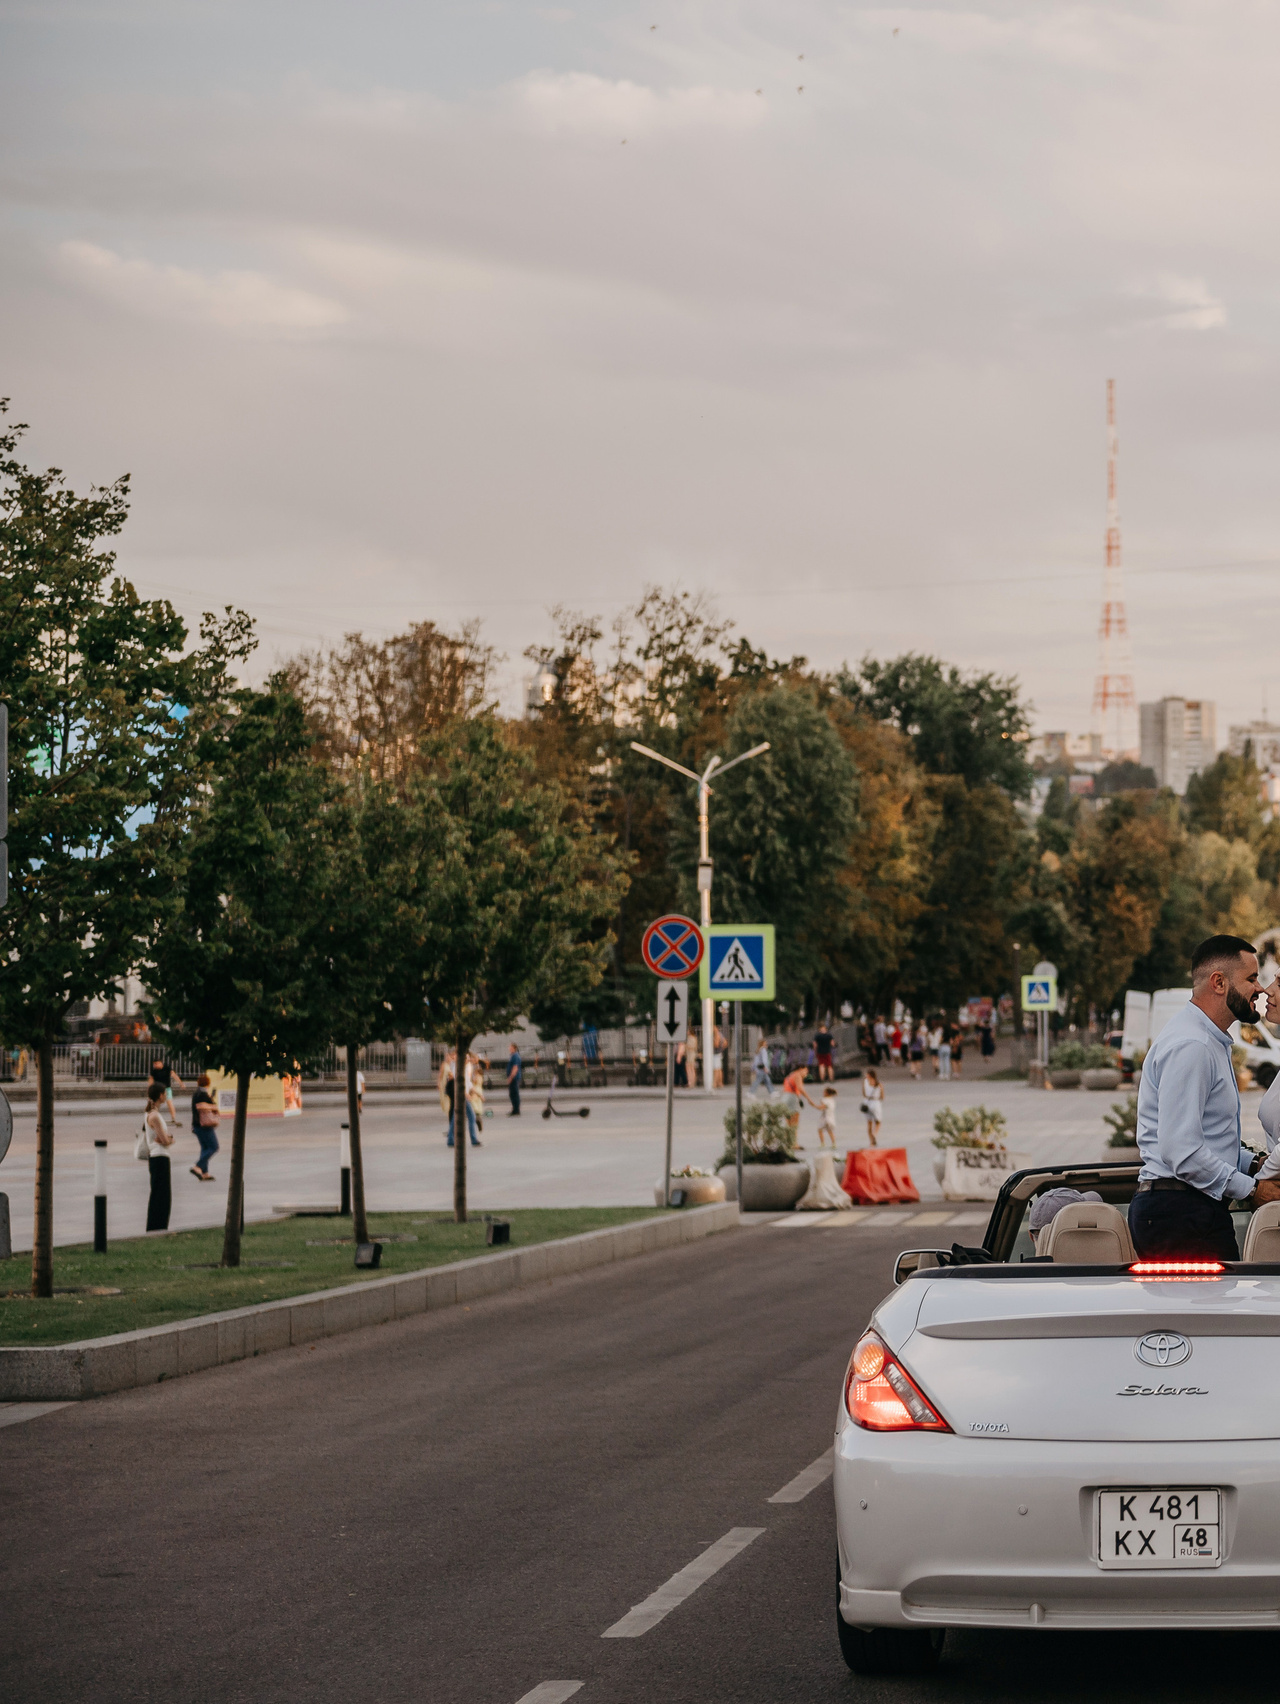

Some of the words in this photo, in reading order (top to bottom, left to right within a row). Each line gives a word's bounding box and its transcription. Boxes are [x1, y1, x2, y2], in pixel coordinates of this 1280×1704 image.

[1116, 1383, 1209, 1396] Solara
[969, 1422, 1010, 1432] TOYOTA
[1149, 1494, 1199, 1521] 481
[1181, 1527, 1208, 1547] 48
[1180, 1548, 1199, 1556] RUS
